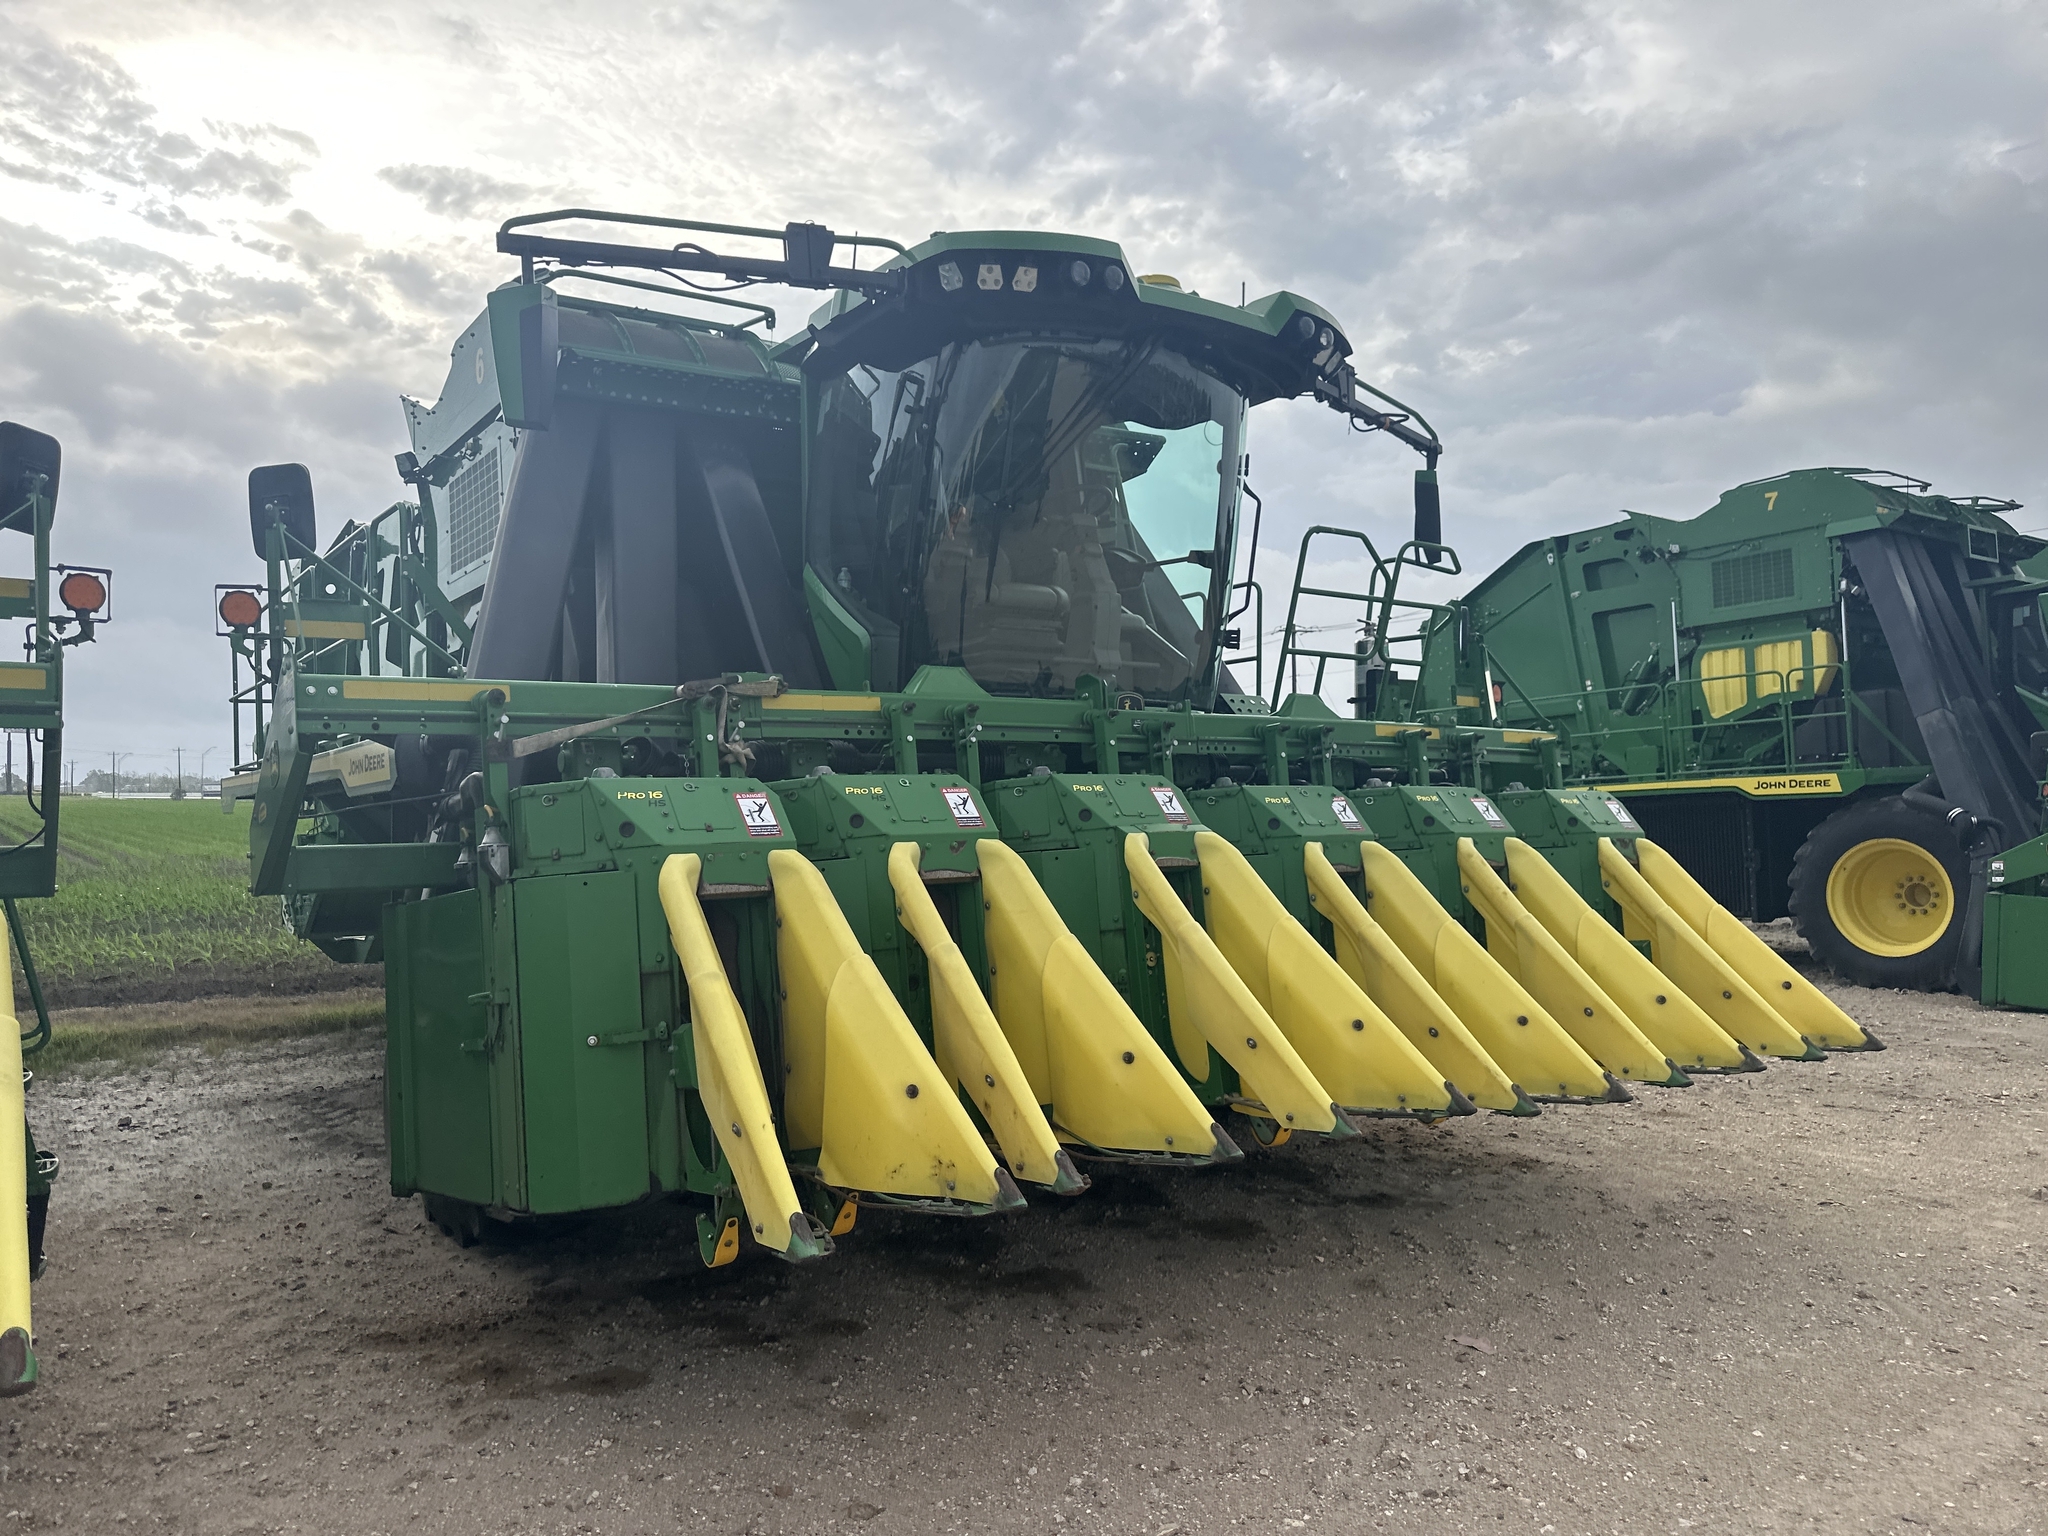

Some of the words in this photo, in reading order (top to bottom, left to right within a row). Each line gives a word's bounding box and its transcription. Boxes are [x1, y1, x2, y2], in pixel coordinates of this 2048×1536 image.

[475, 347, 484, 384] 6
[1764, 491, 1778, 511] 7
[348, 758, 364, 776] JOHN
[364, 752, 386, 772] DEERE
[1072, 784, 1092, 792] PRO
[1754, 780, 1786, 790] JOHN
[1789, 779, 1831, 788] DEERE
[647, 790, 663, 799] 16
[845, 787, 869, 795] PRO
[870, 786, 884, 794] 16
[871, 794, 887, 802] HS
[648, 799, 667, 807] HS
